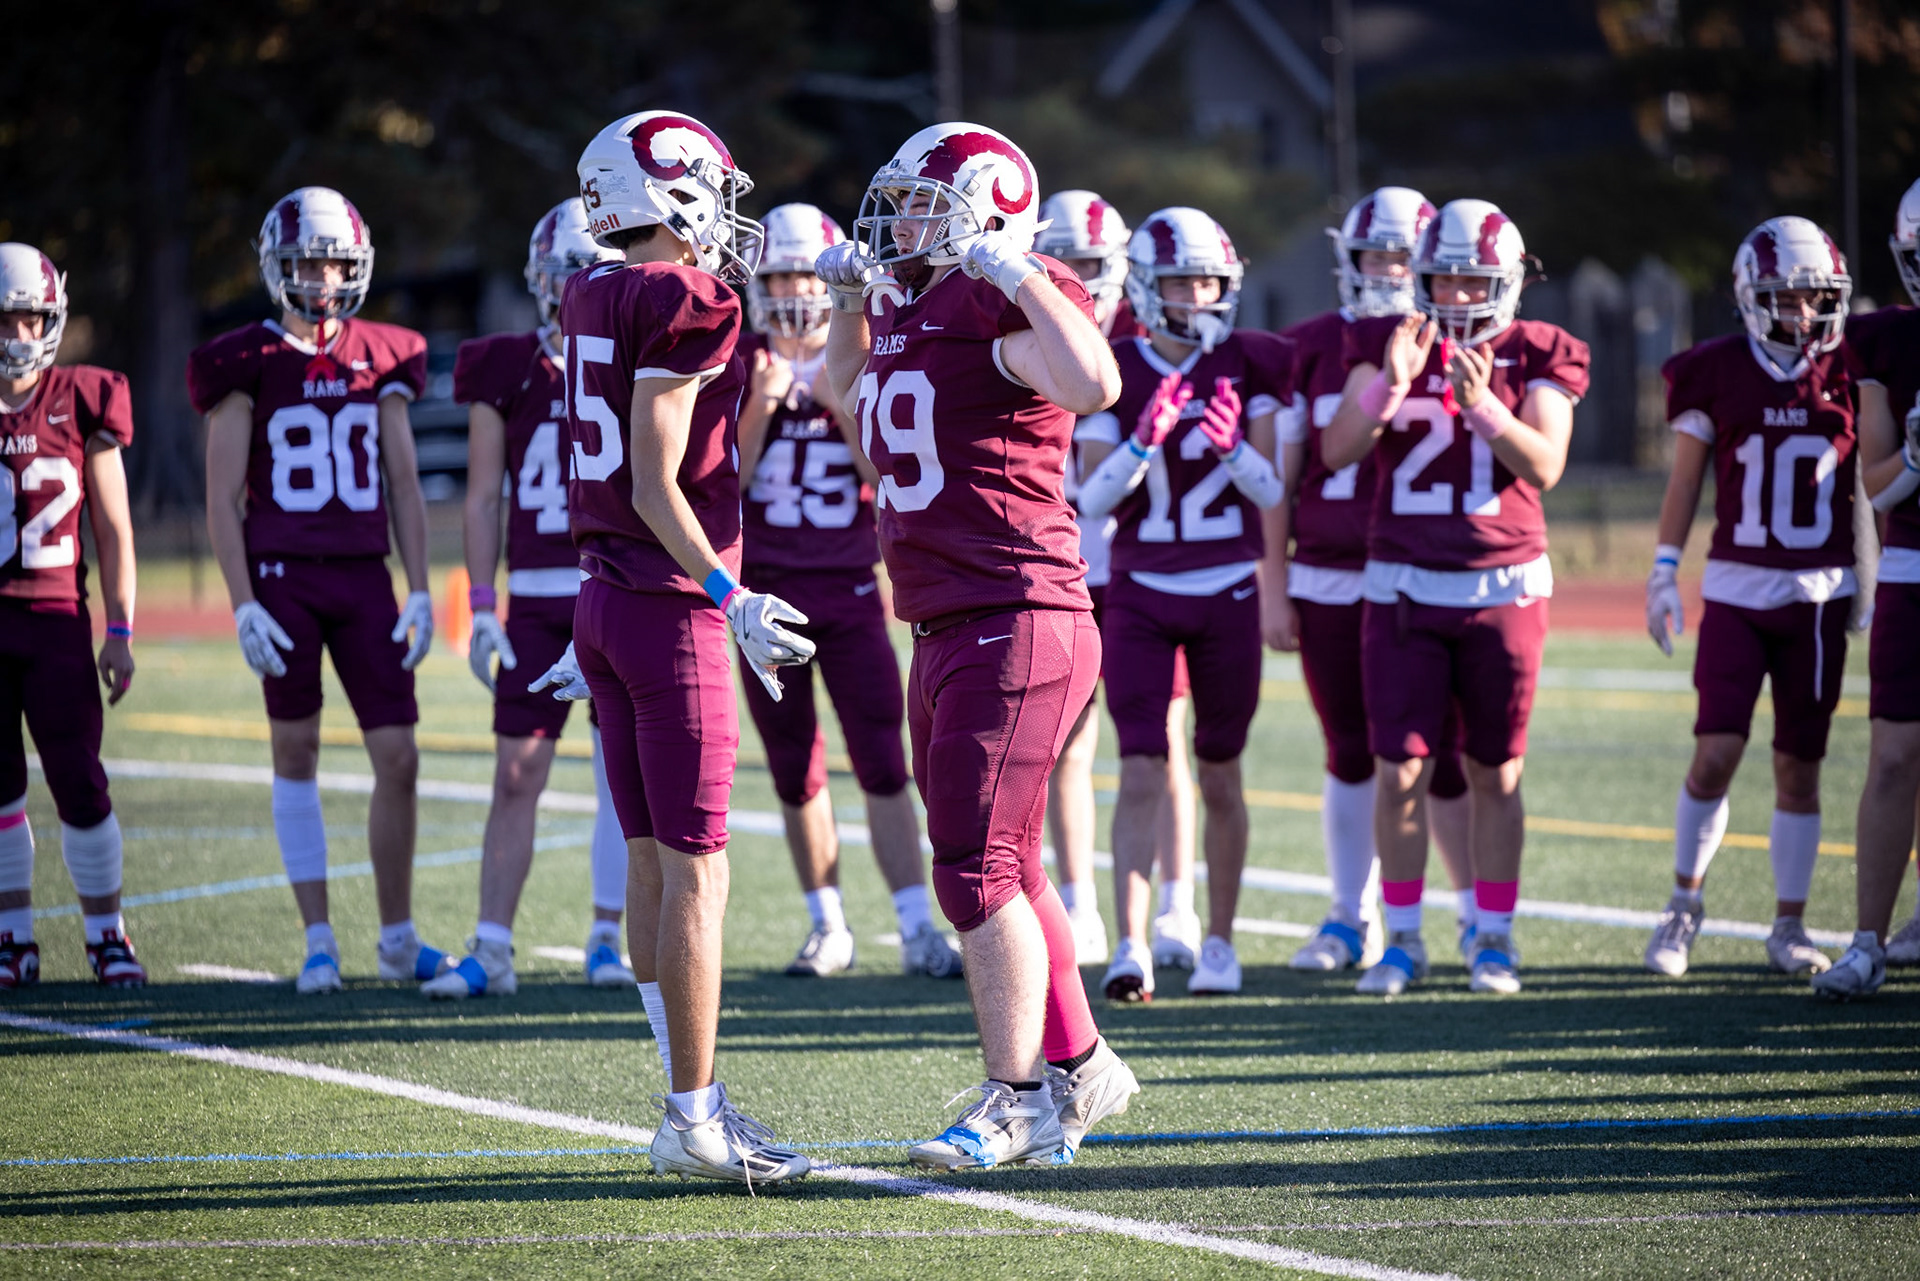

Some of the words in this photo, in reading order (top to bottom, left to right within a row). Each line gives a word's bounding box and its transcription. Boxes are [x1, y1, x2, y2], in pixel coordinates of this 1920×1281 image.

[873, 334, 907, 355] RAMS
[267, 402, 379, 512] 80
[780, 418, 829, 439] RAMS
[1391, 396, 1501, 516] 21
[1763, 407, 1809, 427] RAMS
[749, 438, 858, 530] 45
[1136, 425, 1244, 543] 12
[1733, 433, 1839, 550] 10
